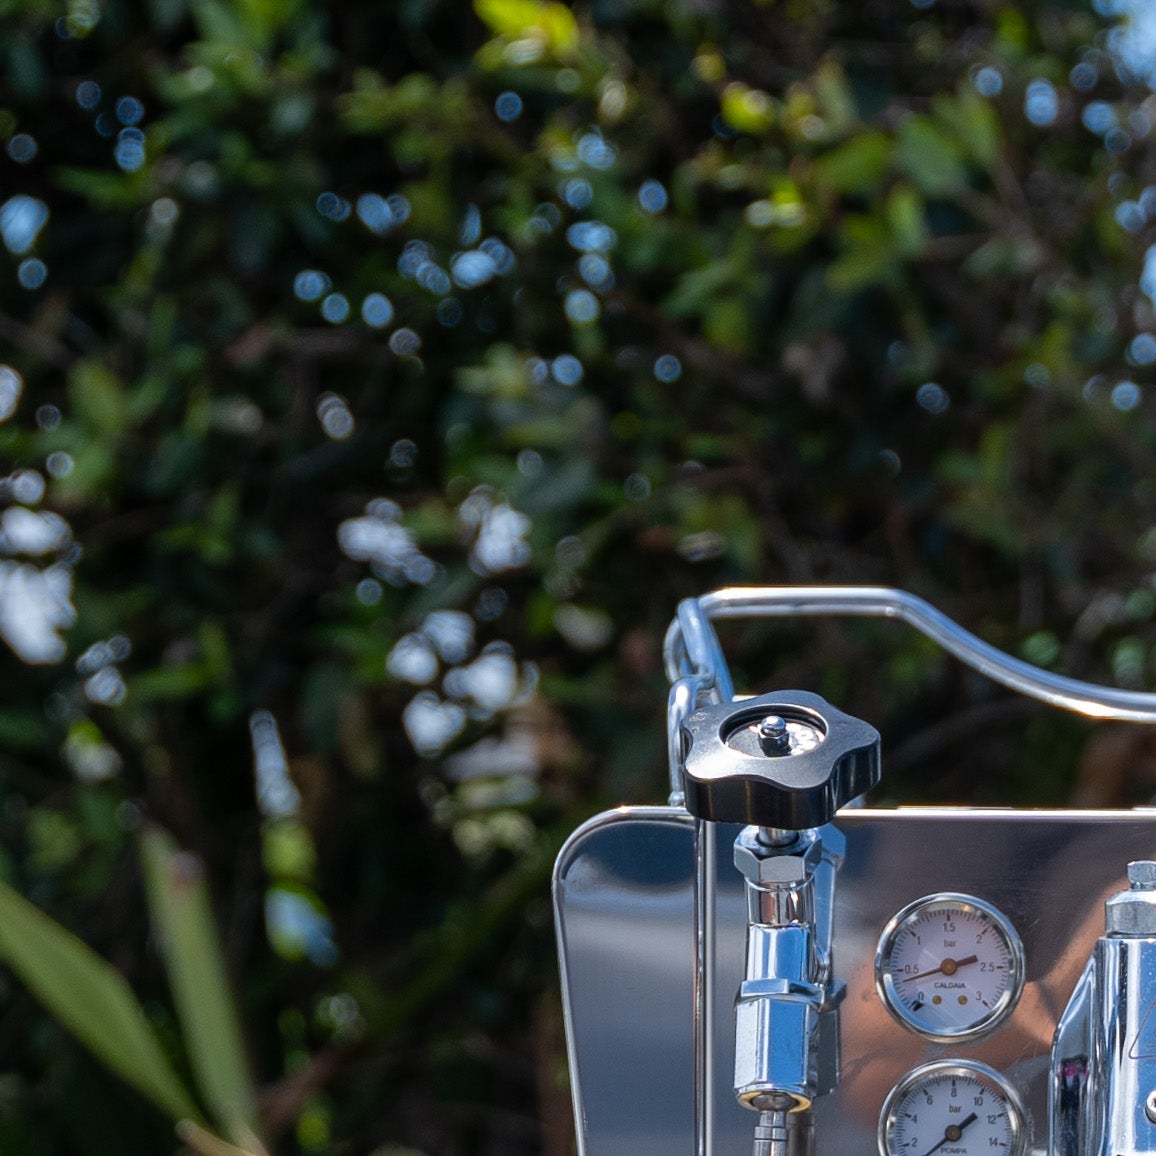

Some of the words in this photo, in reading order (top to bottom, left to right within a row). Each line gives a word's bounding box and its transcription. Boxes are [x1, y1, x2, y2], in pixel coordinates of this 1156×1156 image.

[943, 939, 957, 947] bar
[976, 935, 982, 944] 2
[904, 964, 919, 975] 0.5
[918, 991, 924, 1000] 0
[976, 991, 982, 1001] 3
[951, 1088, 957, 1097] 8
[927, 1096, 933, 1105] 6
[974, 1097, 983, 1106] 10
[911, 1115, 918, 1124] 4
[987, 1115, 996, 1124] 12
[912, 1138, 918, 1147] 2
[989, 1137, 997, 1146] 14
